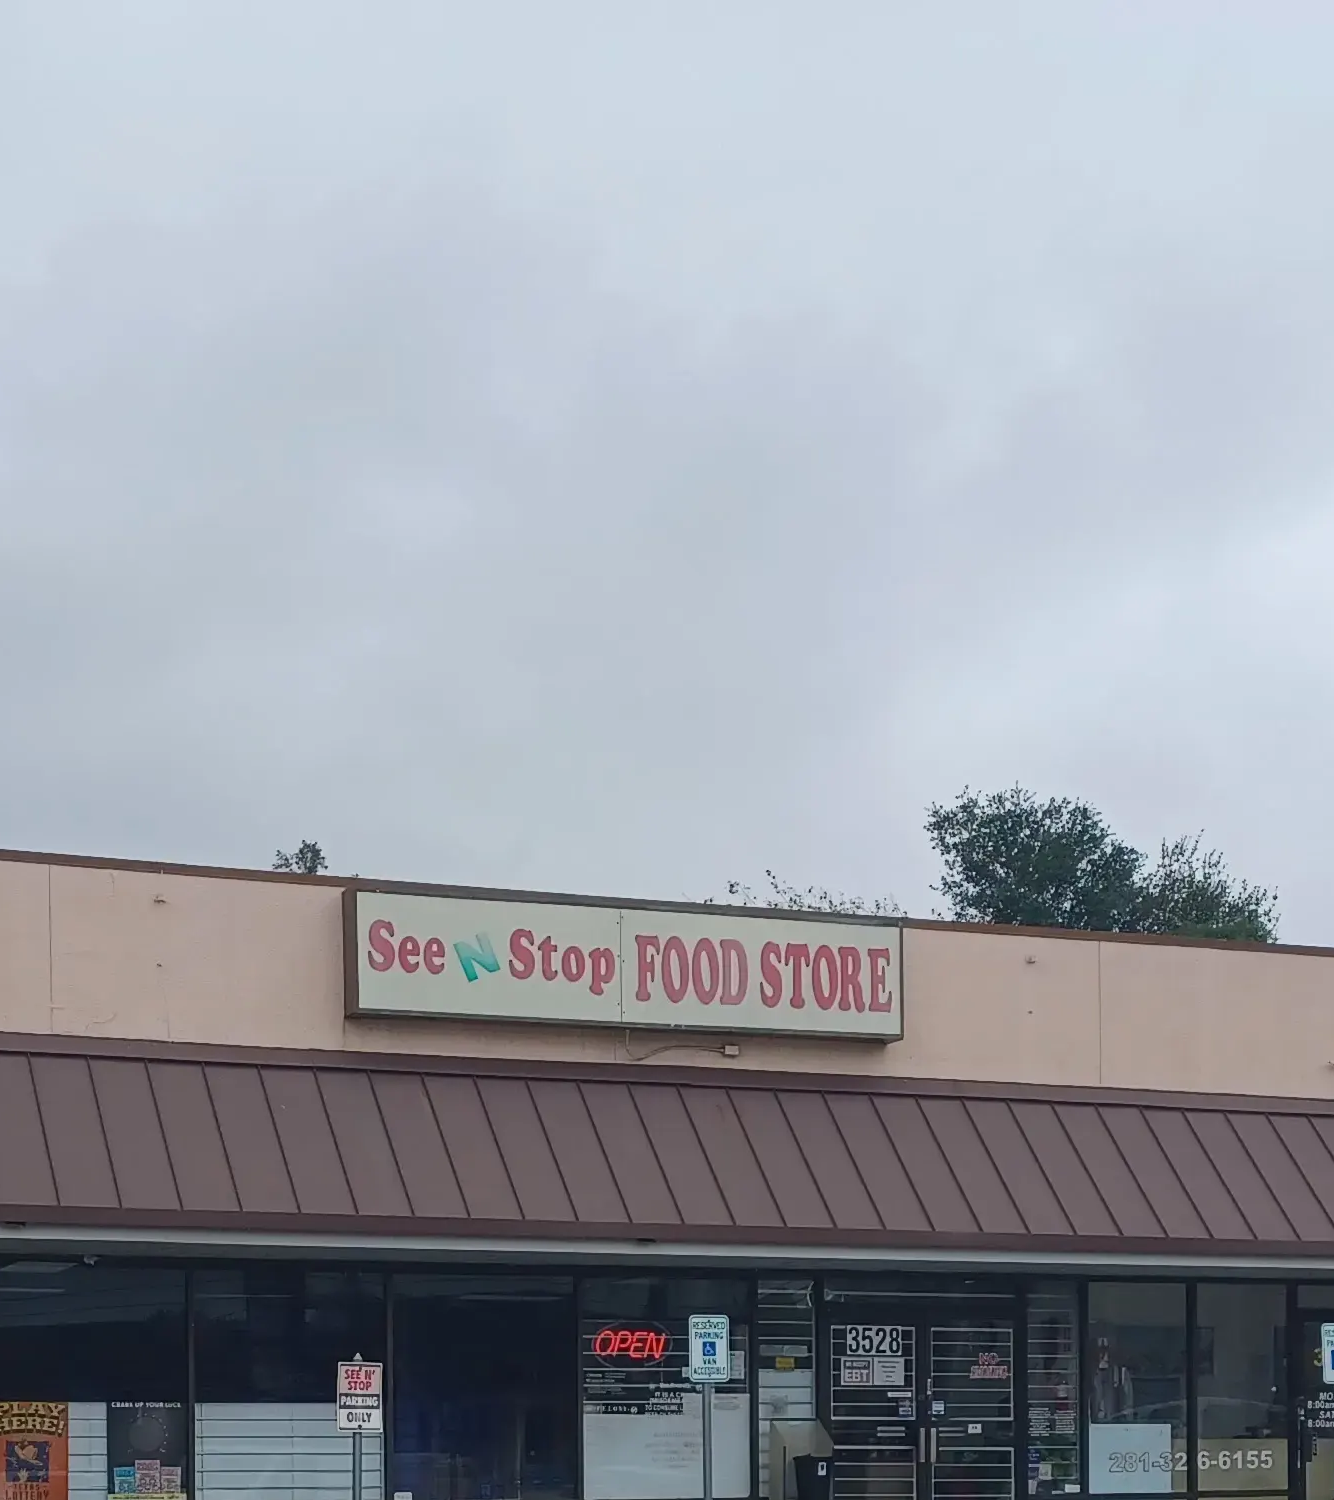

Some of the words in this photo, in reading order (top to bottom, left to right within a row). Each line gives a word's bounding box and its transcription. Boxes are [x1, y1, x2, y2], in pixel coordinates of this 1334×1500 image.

[368, 919, 445, 974] See
[453, 932, 501, 983] N
[509, 928, 615, 996] Stop
[635, 935, 748, 1006] FOOD
[760, 942, 893, 1013] STORE
[692, 1321, 726, 1330] RESERVED
[694, 1331, 724, 1340] PARKING
[848, 1326, 901, 1354] 3528
[595, 1330, 666, 1359] OPEN
[702, 1357, 717, 1366] VAN
[344, 1369, 361, 1380] SEE
[846, 1369, 869, 1382] EBT
[347, 1380, 372, 1391] STOP
[340, 1395, 378, 1407] PARKING
[1319, 1391, 1334, 1400] MO
[347, 1411, 372, 1423] ONLY
[11, 1483, 41, 1492] TEXAS
[4, 1489, 49, 1500] LOTTERY
